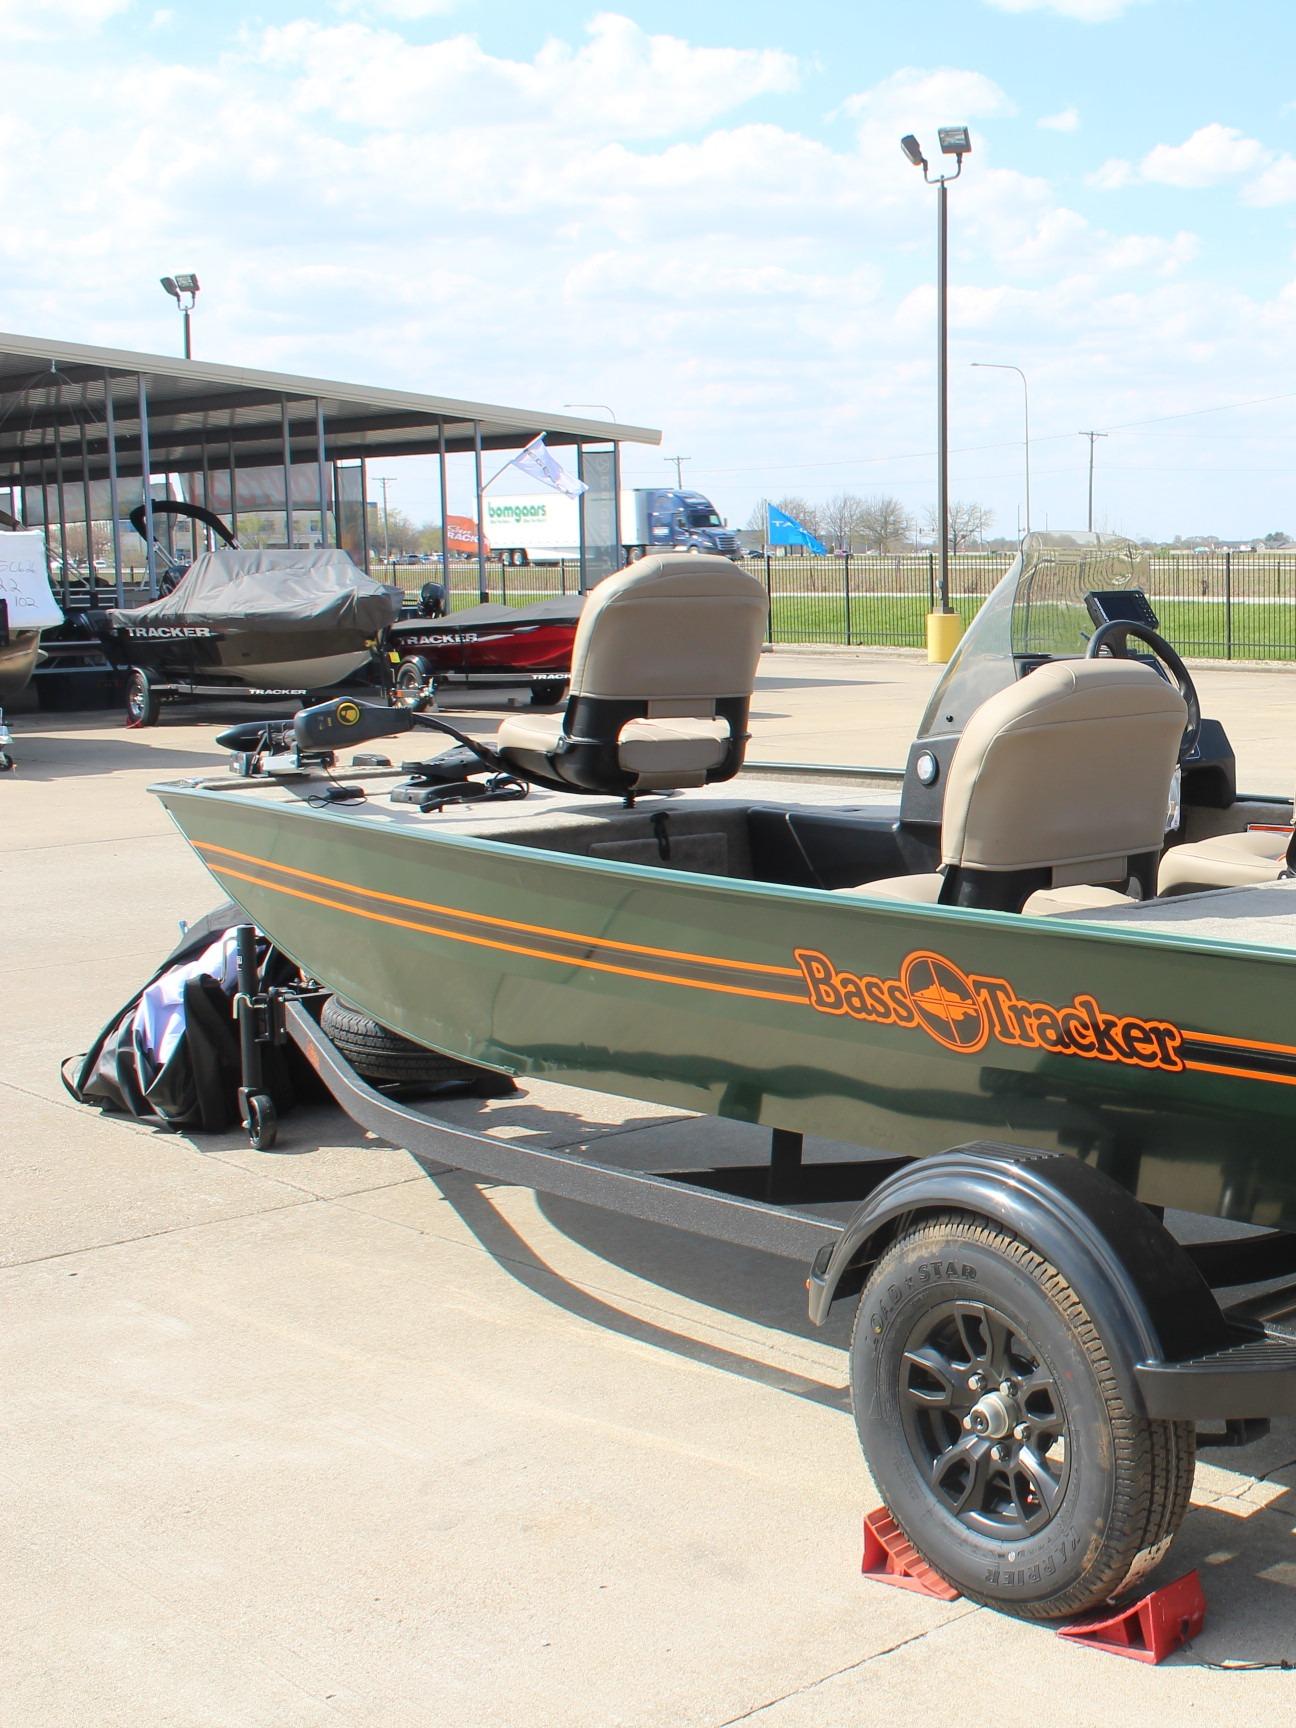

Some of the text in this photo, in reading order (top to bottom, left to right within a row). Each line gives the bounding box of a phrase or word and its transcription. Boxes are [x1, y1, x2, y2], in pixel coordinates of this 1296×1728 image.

[488, 501, 547, 523] bomgaars
[127, 627, 211, 638] TRACKER
[399, 632, 479, 645] TRACKER
[793, 949, 1185, 1072] Bass Tracker
[918, 1260, 978, 1282] STAR
